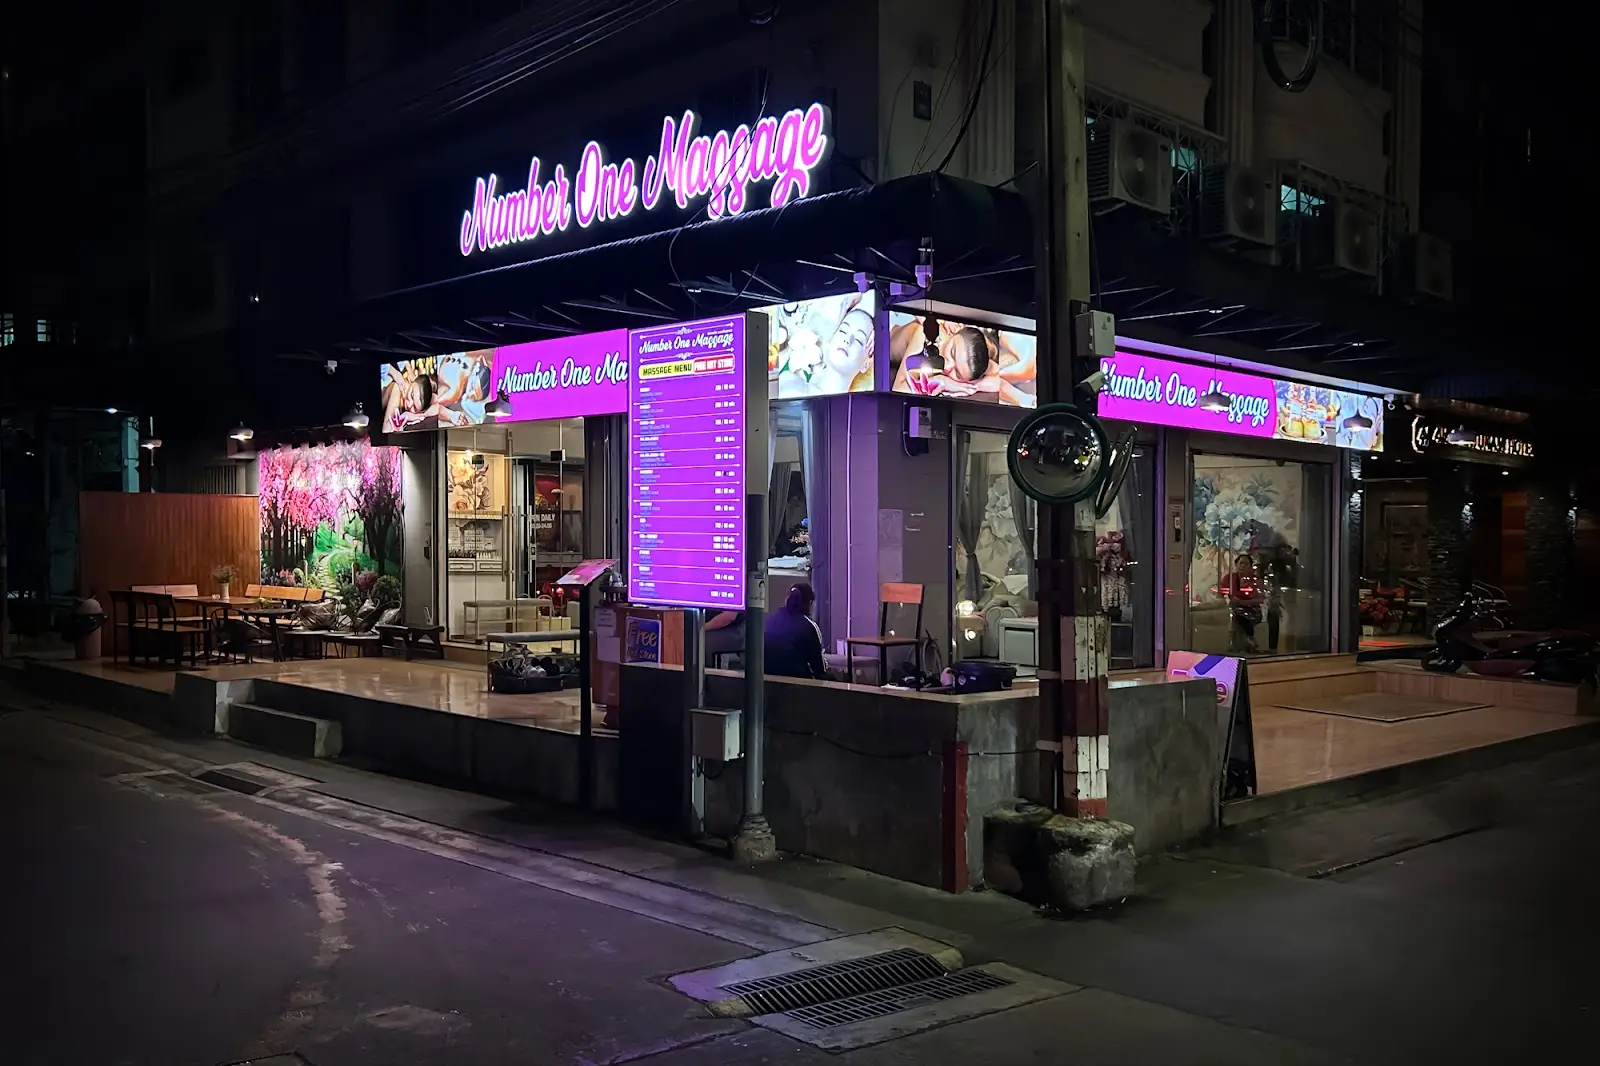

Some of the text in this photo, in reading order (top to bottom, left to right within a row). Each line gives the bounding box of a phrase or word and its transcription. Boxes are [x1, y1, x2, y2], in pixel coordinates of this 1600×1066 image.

[460, 102, 826, 257] Number One Massage
[639, 338, 672, 354] Number
[673, 336, 691, 350] One
[497, 360, 557, 395] Number
[560, 357, 592, 387] One
[642, 365, 672, 376] MASSAGE
[674, 363, 692, 372] MENU
[1165, 371, 1197, 408] One
[1200, 379, 1270, 428] Mssage
[541, 513, 556, 521] DAILY
[628, 621, 658, 647] Free
